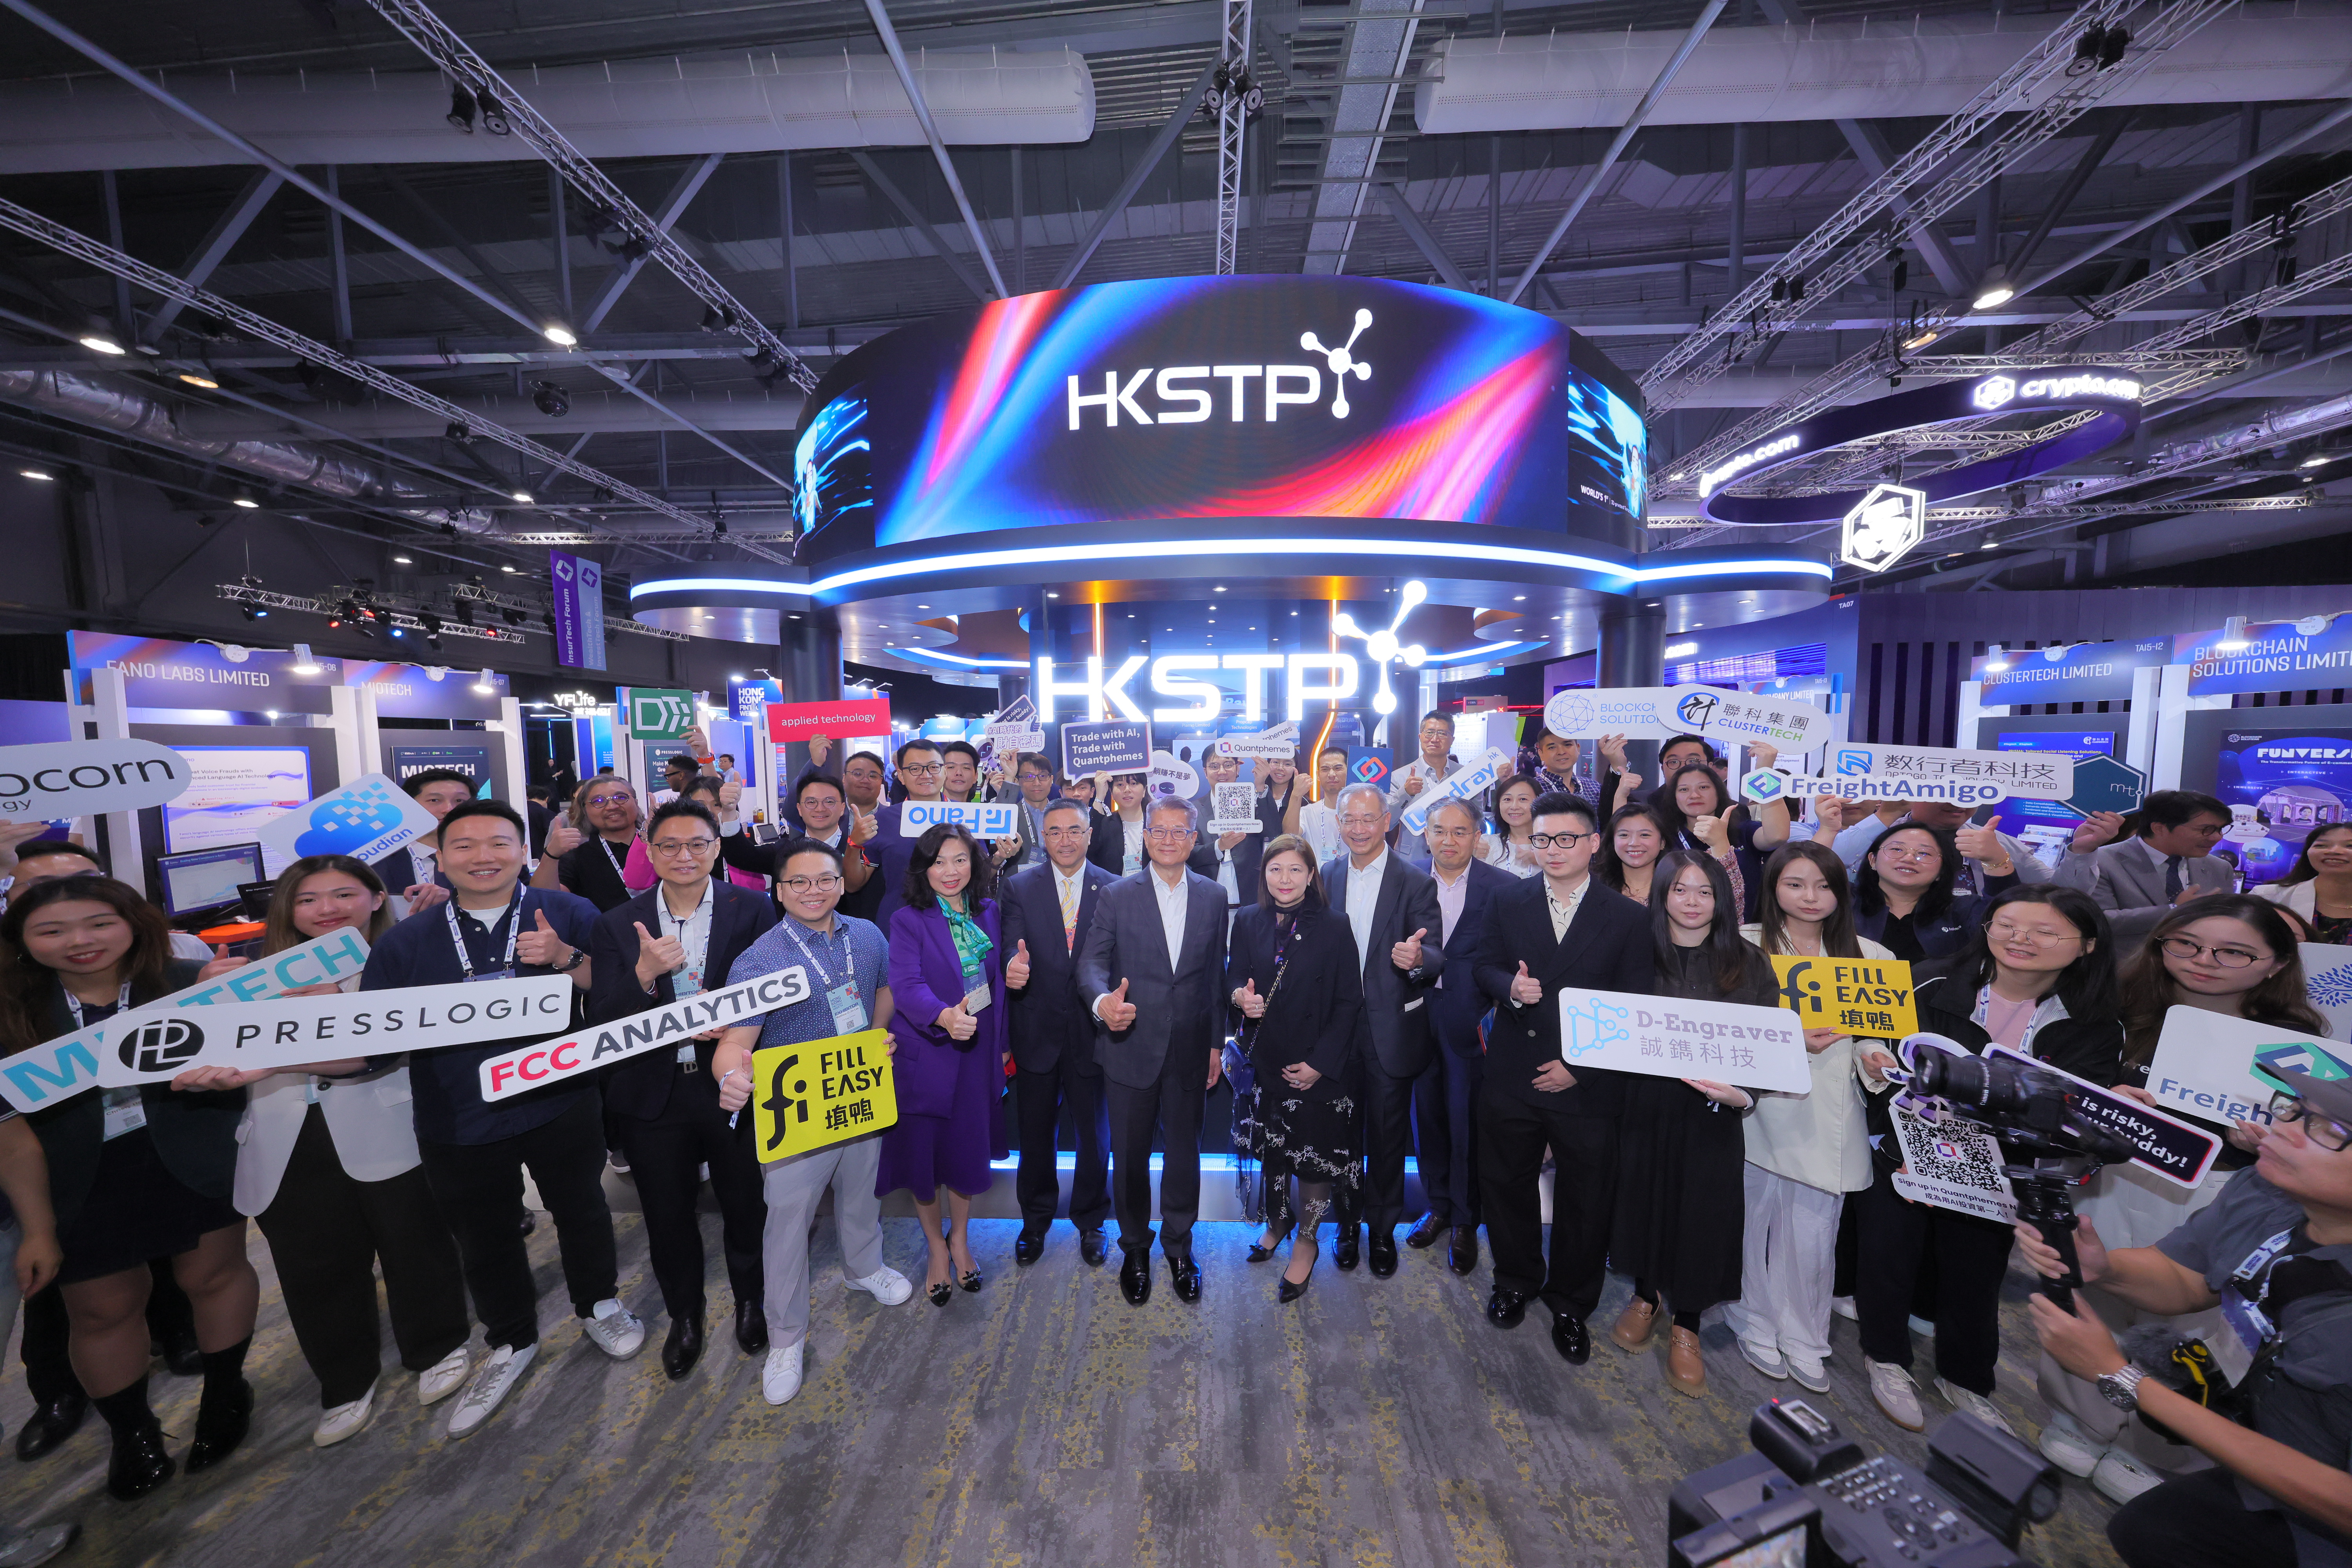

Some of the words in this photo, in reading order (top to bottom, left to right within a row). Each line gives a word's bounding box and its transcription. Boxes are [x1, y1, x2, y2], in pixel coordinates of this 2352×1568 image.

[1068, 365, 1320, 430] HKSTP
[1581, 485, 1603, 501] WORLD'S
[1838, 601, 1854, 610] TA07
[565, 619, 574, 663] InsurTech
[1984, 666, 2060, 685] CLUSTERTECH
[2062, 662, 2112, 680] LIMITED
[2192, 656, 2290, 678] SOLUTIONS
[2295, 650, 2352, 671] LIMIT
[161, 664, 205, 682] LABS
[210, 669, 270, 687] LIMITED
[361, 681, 412, 696] MIOTECH
[554, 691, 595, 706] YFLife
[738, 687, 765, 696] HONG
[1037, 654, 1359, 723] HKSTP
[1790, 690, 1814, 701] LIMITED
[739, 696, 765, 704] KONG
[1600, 702, 1656, 712] BLOCKC
[781, 714, 818, 728] applied
[821, 712, 876, 725] technology
[1010, 707, 1022, 719] risky,
[1016, 706, 1031, 720] buddy!
[1600, 715, 1659, 724] SOLUTIO
[1723, 703, 1809, 731] 聯科集團
[987, 724, 1022, 735] #AI時代的
[1071, 732, 1099, 742] Trade
[1102, 730, 1124, 739] with
[1126, 728, 1140, 738] AI,
[1718, 718, 1803, 742] CLUSTERTECH
[996, 735, 1042, 750] 財自密碼
[1072, 743, 1100, 754] Trade
[1103, 741, 1125, 751] with
[1234, 744, 1290, 753] Quantphemes
[1073, 752, 1143, 768] Quantphemes
[1488, 751, 1499, 760] hk
[2257, 748, 2352, 759] FUNVERS
[1884, 754, 2055, 780] 数行者科技
[1792, 778, 1999, 803] FreightAmigo
[2011, 780, 2057, 790] LIMITED
[358, 828, 414, 864] oudian
[1835, 966, 1887, 985] FILL
[1836, 986, 1909, 1007] EASY
[2, 934, 367, 1103] MTECH
[835, 1002, 859, 1016] EXHIBITOR
[236, 994, 561, 1049] PRESSLOGIC
[1636, 1010, 1793, 1044] D-Engraver
[1839, 1009, 1894, 1032] 填鴨
[490, 1042, 581, 1093] FCC
[591, 974, 802, 1061] ANALYTICS
[820, 1046, 866, 1074] FILL
[822, 1066, 884, 1100] EASY
[1980, 1089, 1989, 1105] Canon
[2159, 1078, 2274, 1125] Freigh
[825, 1098, 874, 1131] 填鴨
[2081, 1096, 2098, 1112] is
[2101, 1108, 2157, 1140] risky,
[2114, 1126, 2188, 1168] ddy!
[1898, 1178, 1916, 1187] Sign
[1940, 1188, 2007, 1208] Quantphemes
